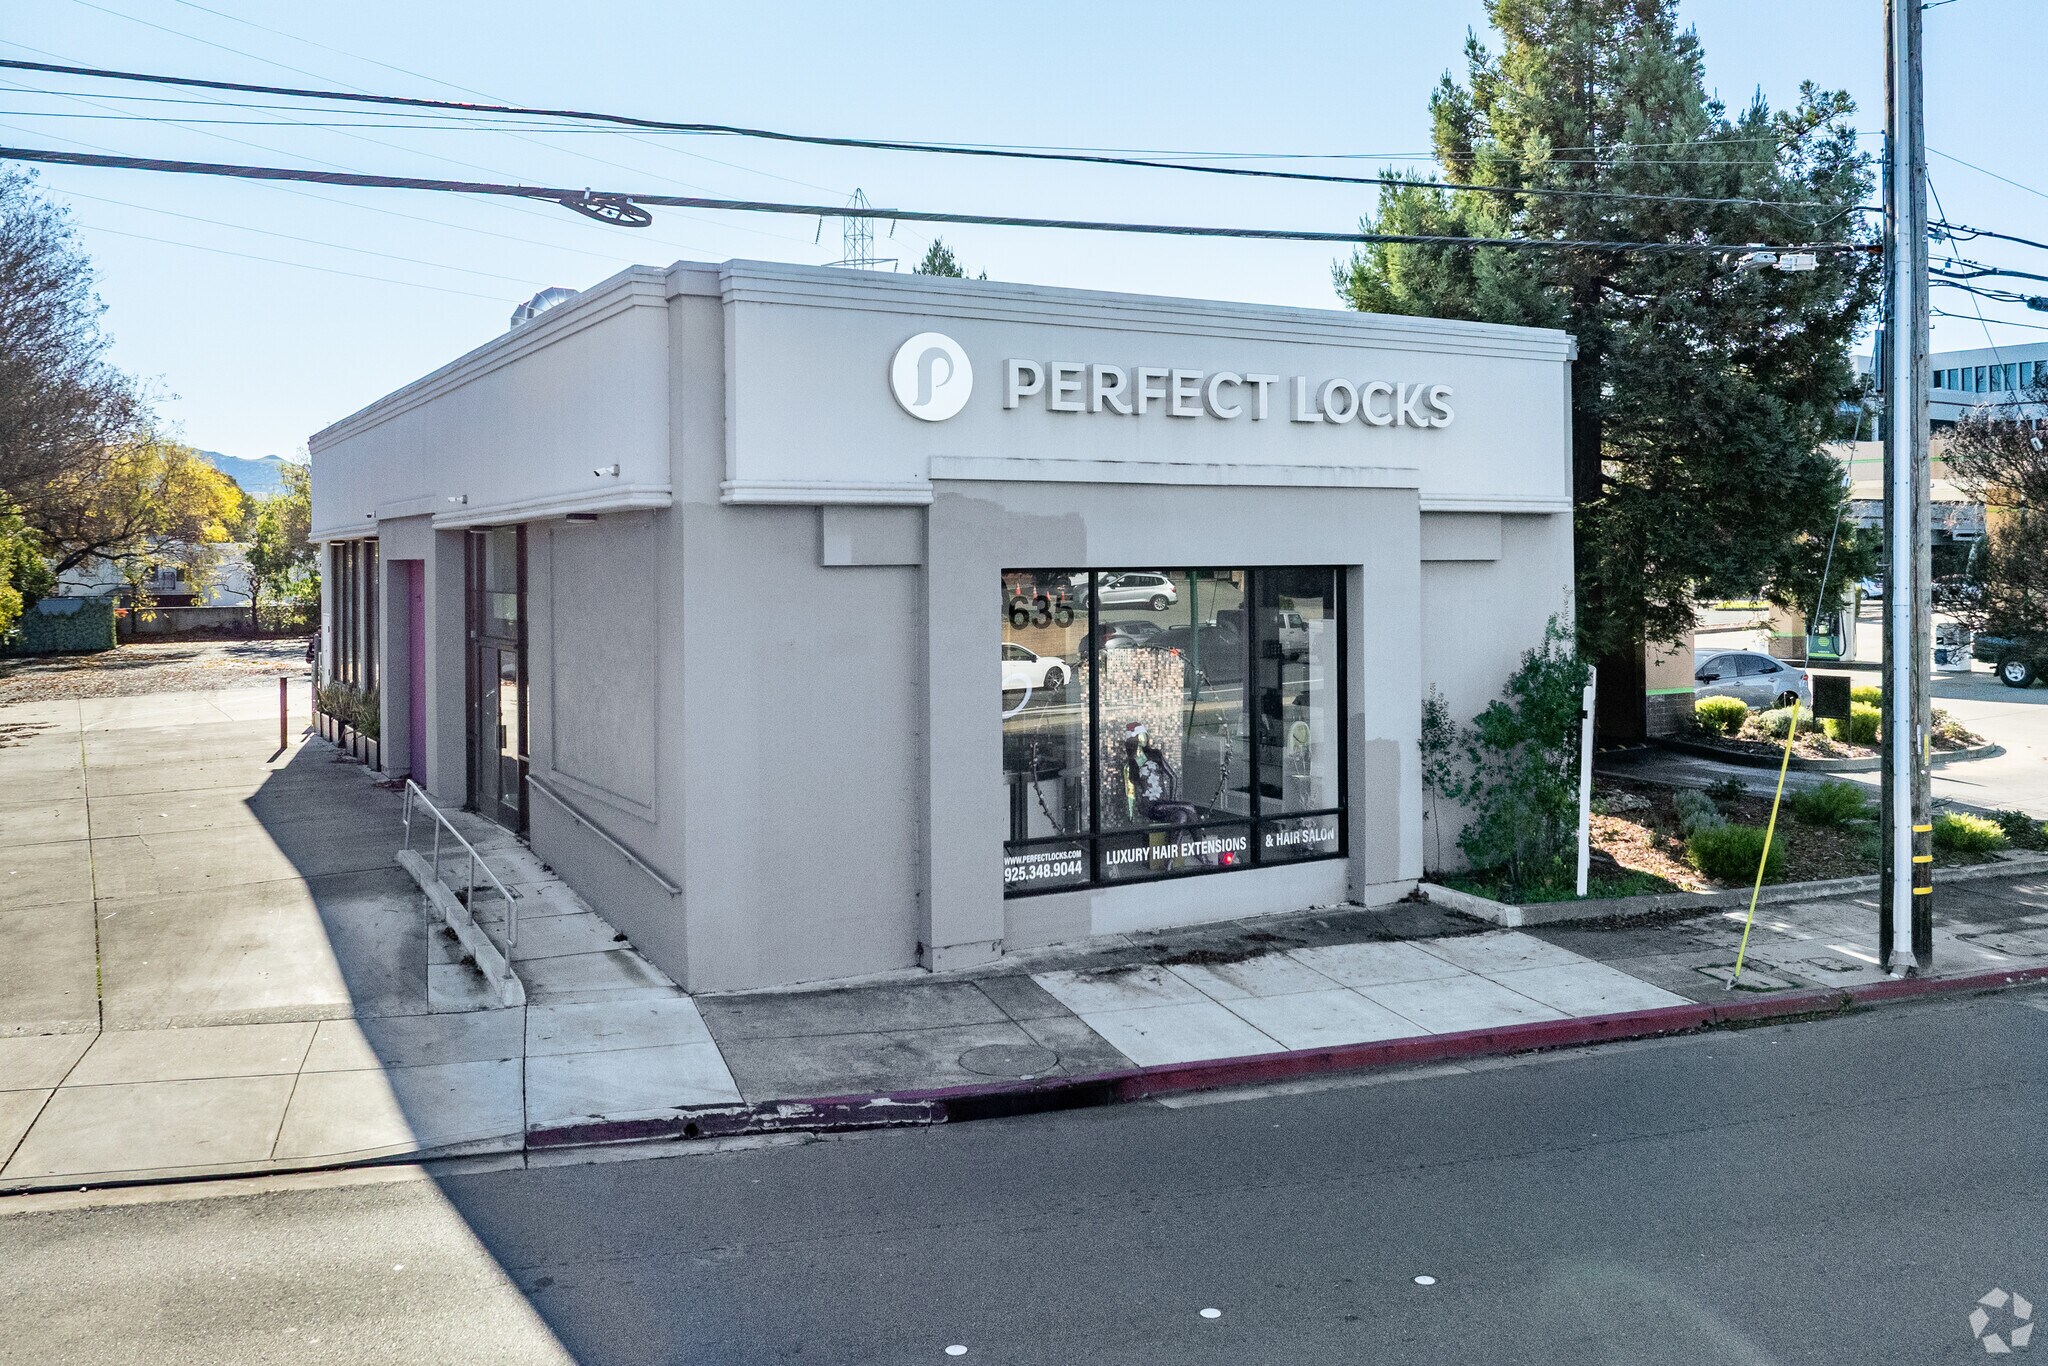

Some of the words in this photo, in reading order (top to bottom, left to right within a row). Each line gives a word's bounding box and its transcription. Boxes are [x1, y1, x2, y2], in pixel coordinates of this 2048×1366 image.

[1003, 357, 1279, 421] PERFECT
[1290, 375, 1454, 428] LOCKS
[1008, 595, 1075, 630] 635
[1004, 850, 1082, 866] WWW.PERFECTLOCKS.COM
[1106, 847, 1150, 865] LUXURY
[1153, 844, 1178, 860] HAIR
[1181, 836, 1247, 857] EXTENSIONS
[1265, 834, 1274, 847] &
[1276, 831, 1300, 846] HAIR
[1302, 828, 1334, 843] SALON
[1004, 860, 1082, 882] 925.348.9044
